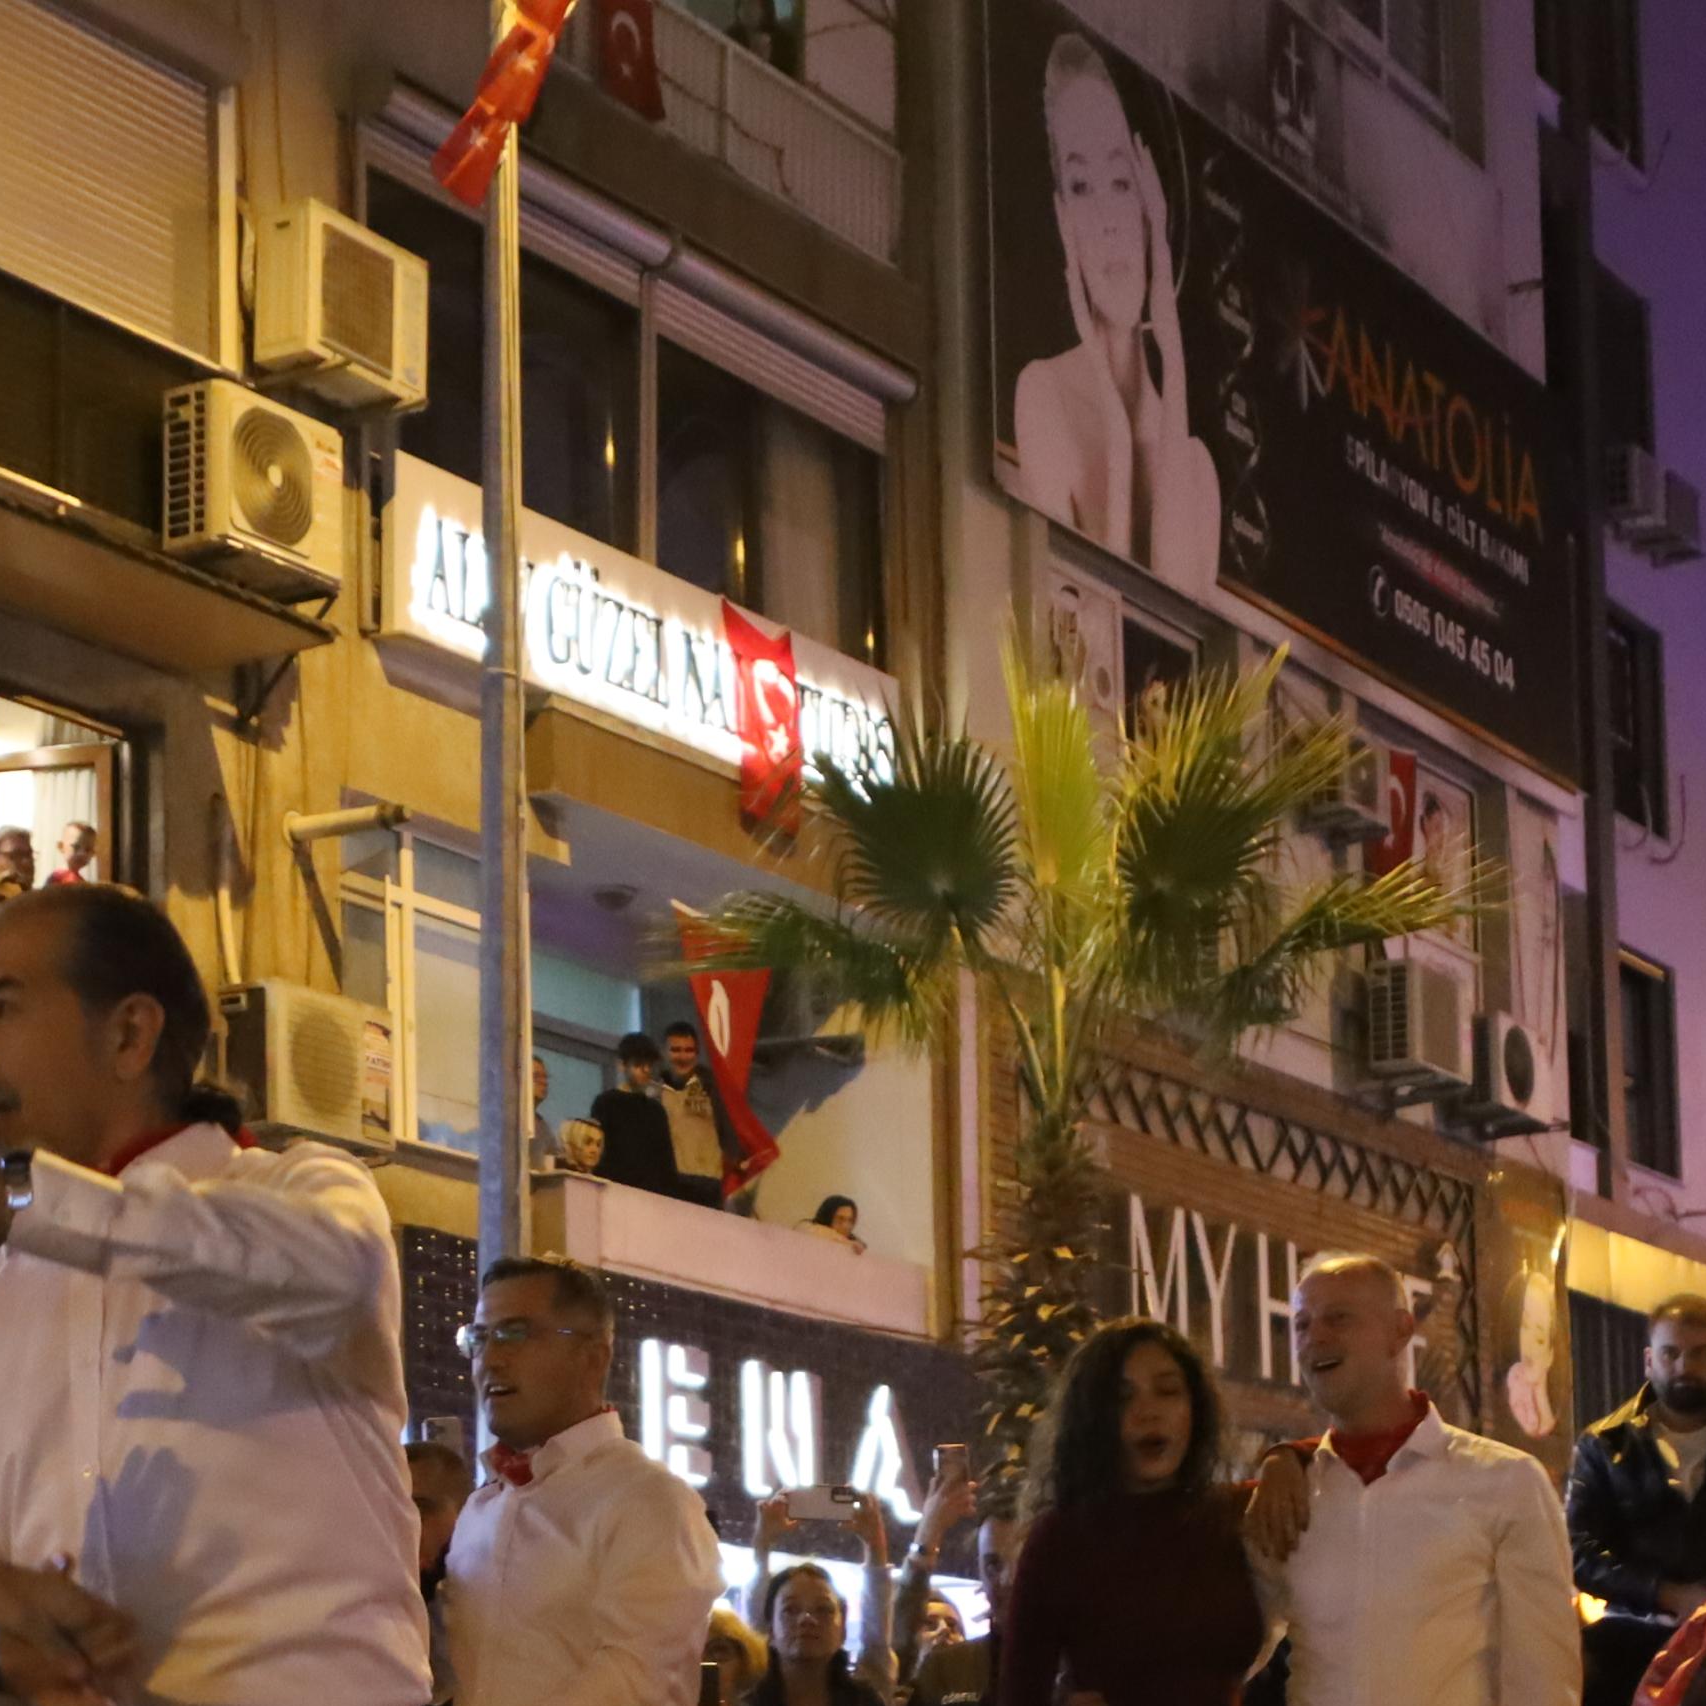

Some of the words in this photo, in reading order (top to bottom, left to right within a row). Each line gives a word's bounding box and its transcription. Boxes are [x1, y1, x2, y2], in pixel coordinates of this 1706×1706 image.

[545, 561, 671, 709] GÜZEL
[1434, 611, 1466, 661] 045
[1469, 635, 1491, 676] 45
[1494, 650, 1516, 691] 04
